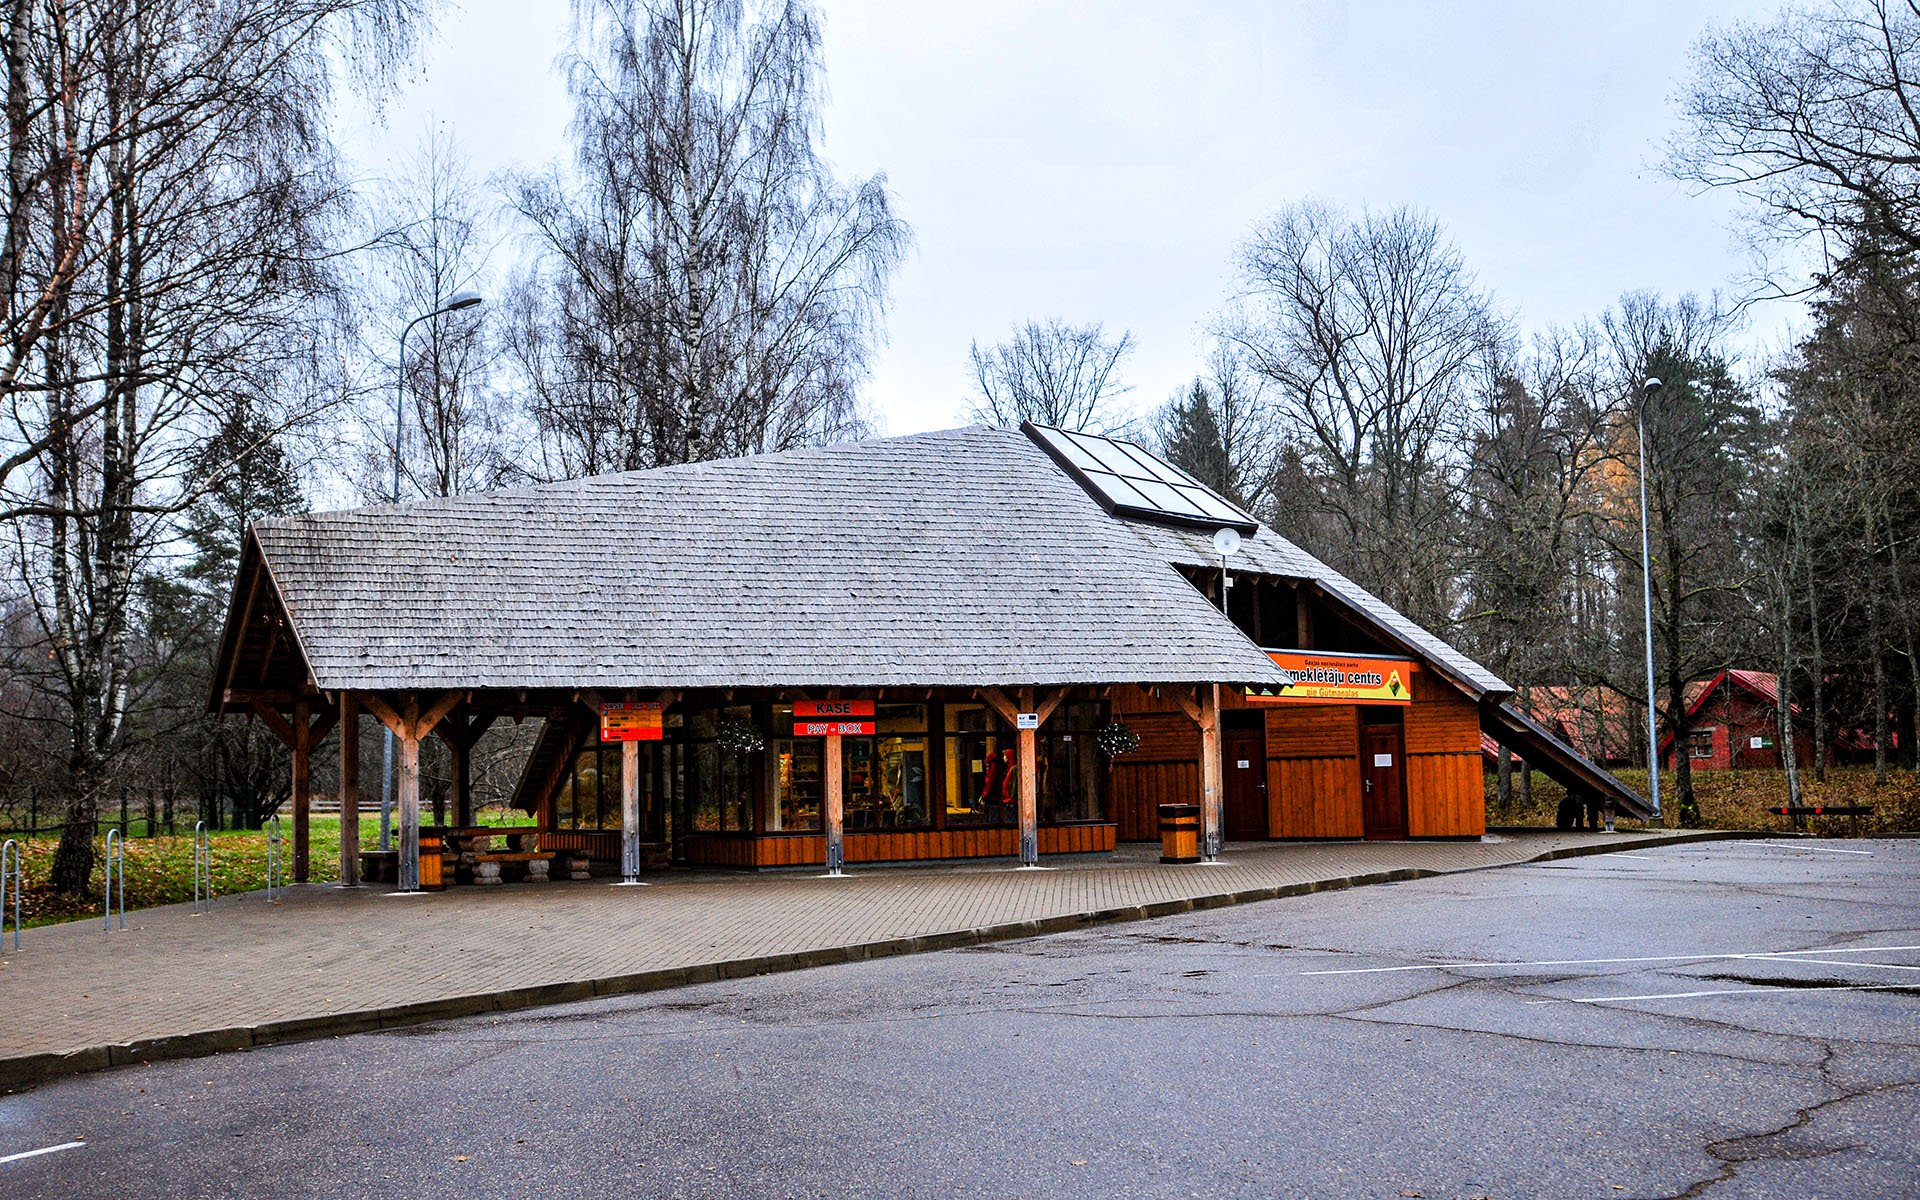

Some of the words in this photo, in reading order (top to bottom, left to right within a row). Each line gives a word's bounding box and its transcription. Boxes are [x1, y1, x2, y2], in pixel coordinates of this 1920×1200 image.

[1285, 667, 1345, 687] meklētāju
[1348, 670, 1381, 685] centrs
[1306, 688, 1317, 698] pie
[816, 703, 852, 714] KASE
[807, 723, 828, 734] PAY
[838, 723, 862, 734] BOX
